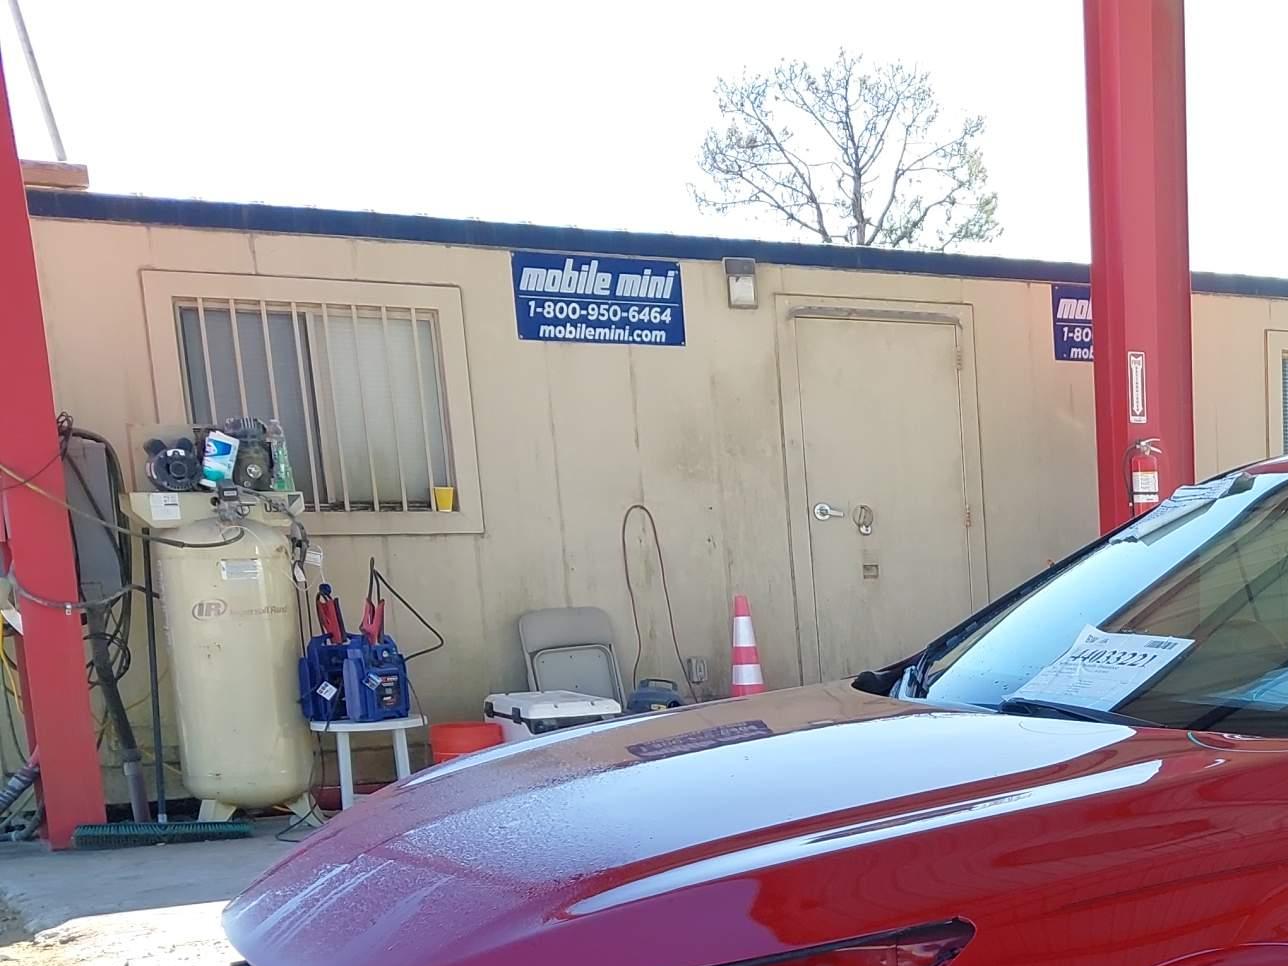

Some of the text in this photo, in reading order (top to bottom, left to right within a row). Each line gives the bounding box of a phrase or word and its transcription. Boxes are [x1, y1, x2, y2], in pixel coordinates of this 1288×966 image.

[519, 258, 675, 299] mobile mini
[528, 300, 672, 324] 1-800-950-6464
[539, 323, 666, 342] mobilemini.com
[1069, 648, 1158, 667] 44033221
